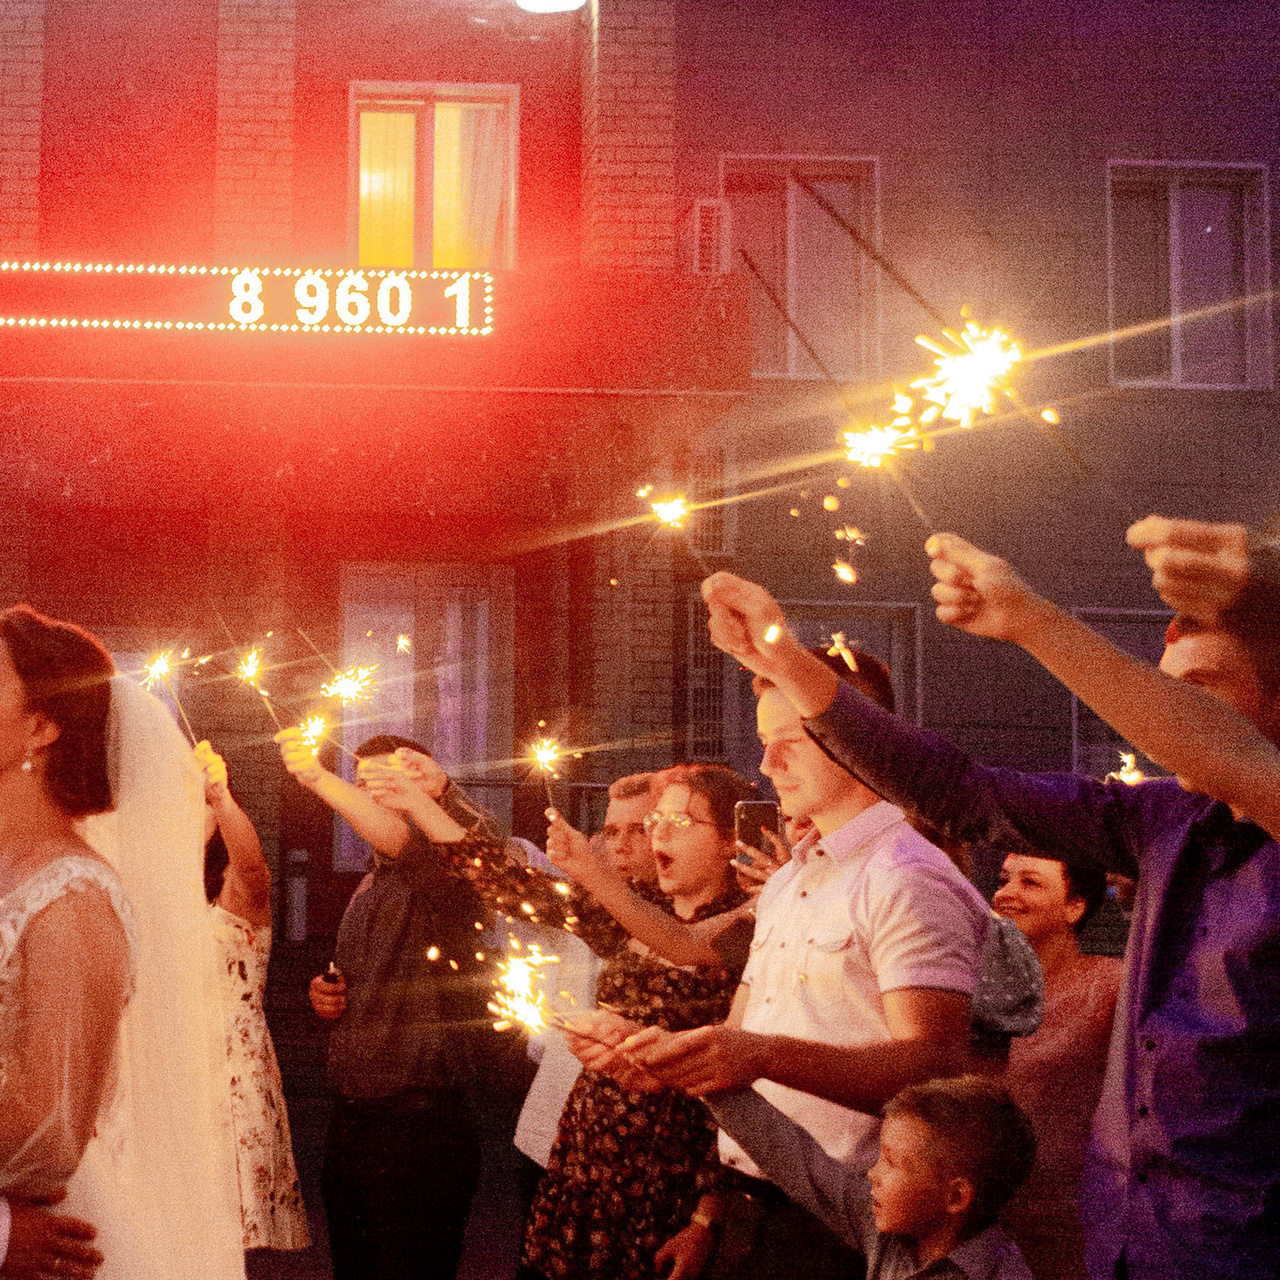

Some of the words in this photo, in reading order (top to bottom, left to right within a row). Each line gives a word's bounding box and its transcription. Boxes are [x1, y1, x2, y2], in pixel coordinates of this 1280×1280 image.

[228, 271, 264, 324] 8
[294, 270, 412, 326] 960
[444, 272, 470, 328] 1
